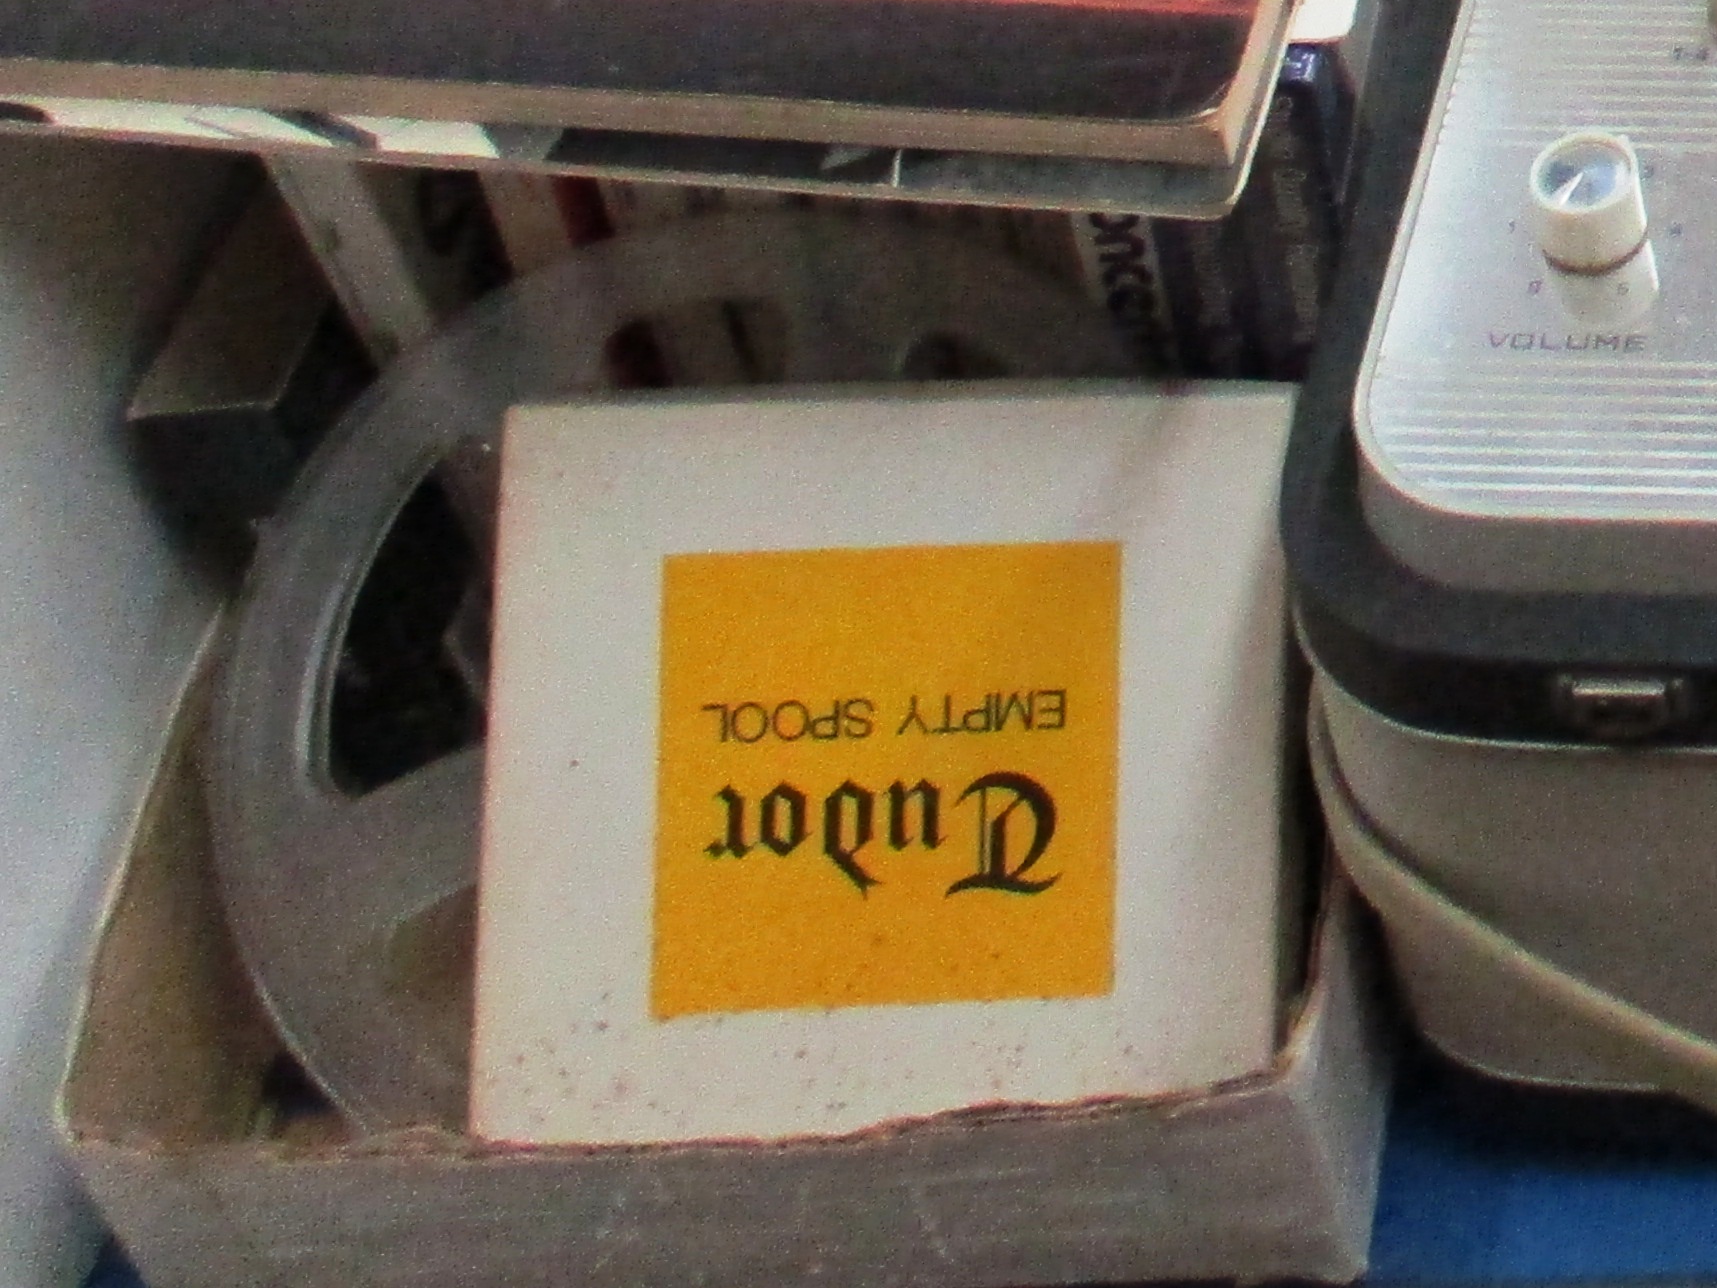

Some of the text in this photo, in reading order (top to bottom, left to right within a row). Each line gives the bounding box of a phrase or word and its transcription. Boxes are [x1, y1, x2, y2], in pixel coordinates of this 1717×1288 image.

[1487, 332, 1650, 352] VOLUME
[703, 689, 1068, 743] EMPTY SPOOL
[703, 770, 1061, 901] Tudor
